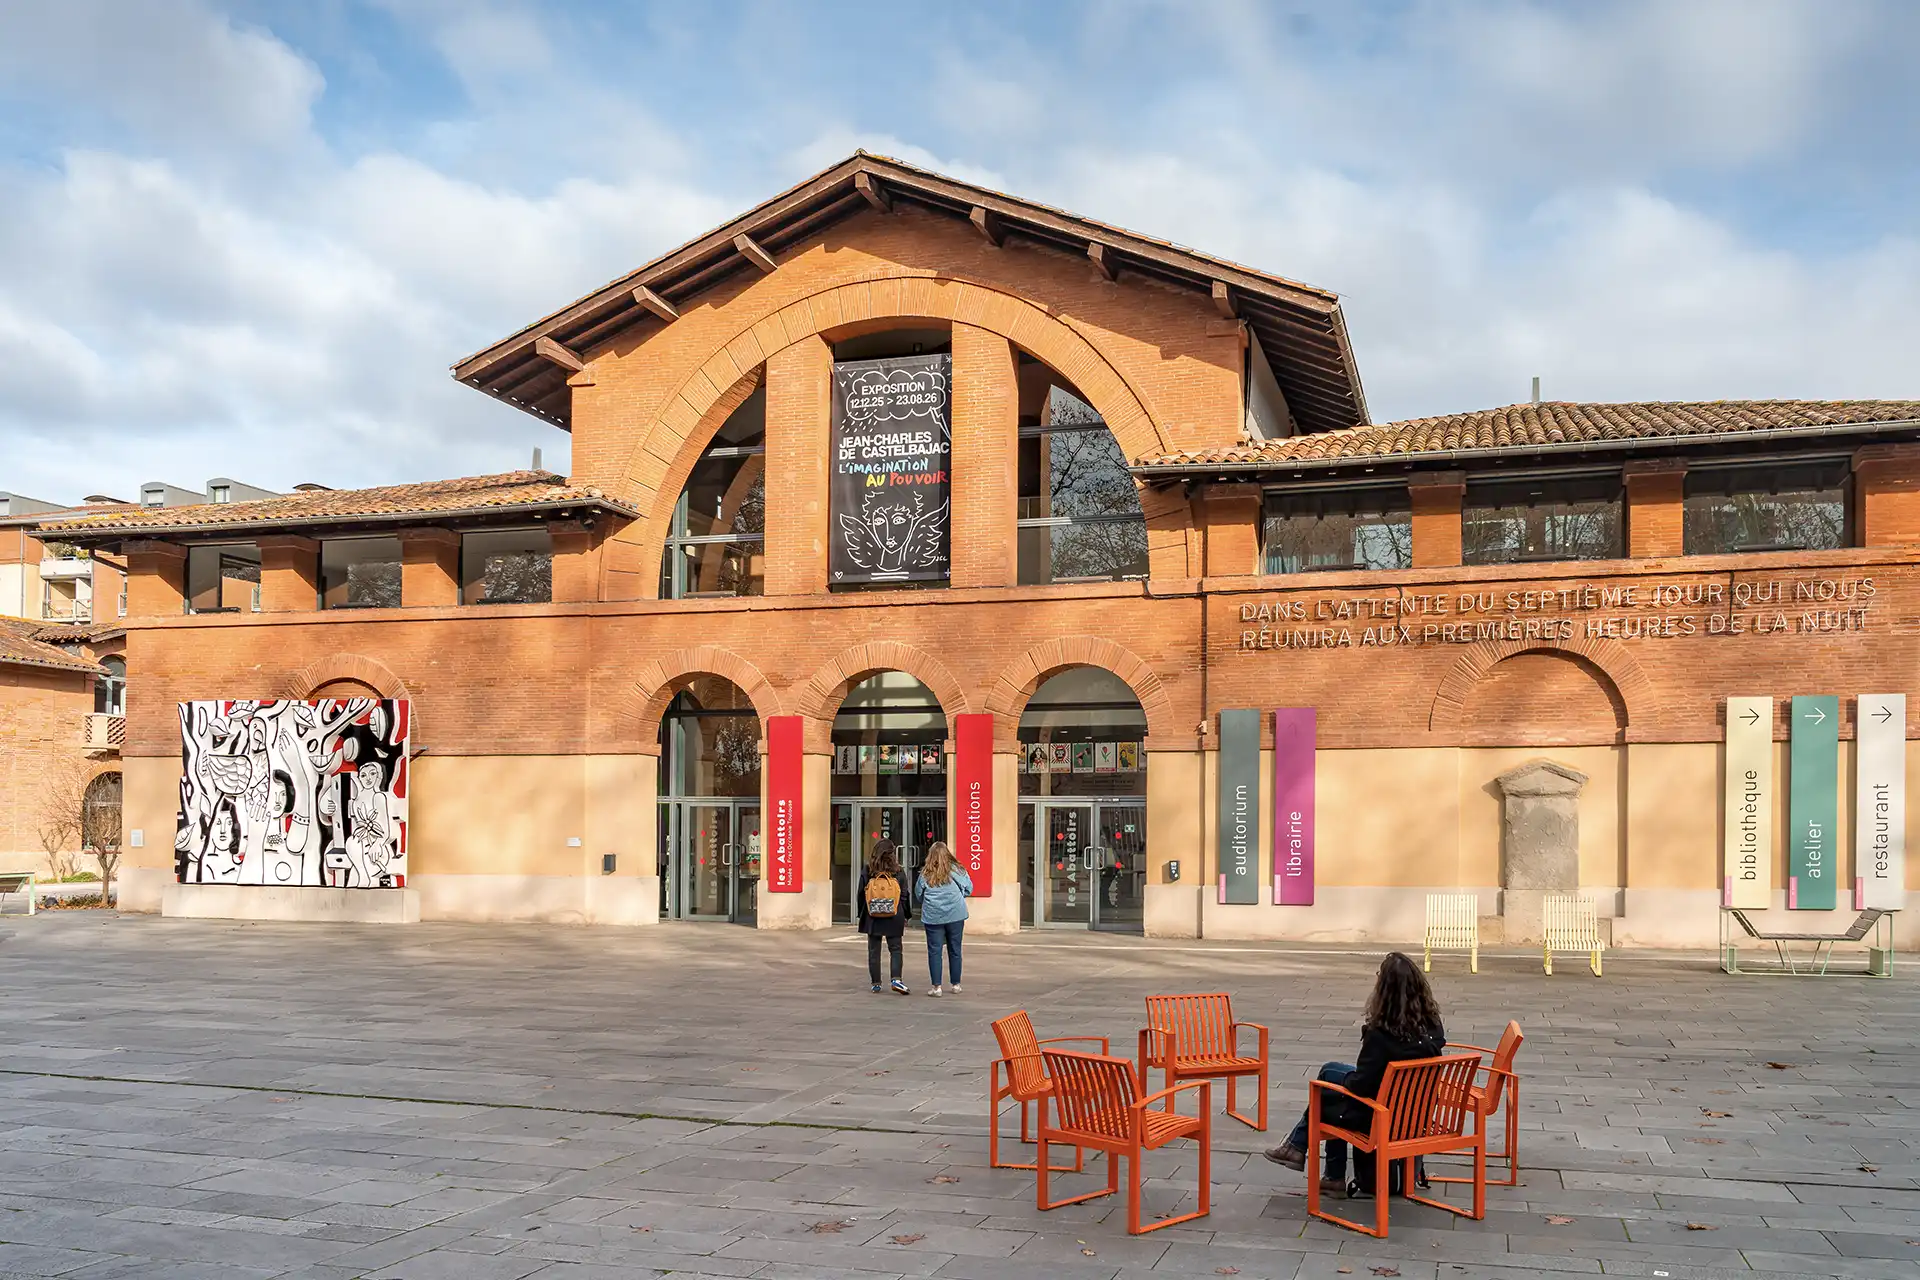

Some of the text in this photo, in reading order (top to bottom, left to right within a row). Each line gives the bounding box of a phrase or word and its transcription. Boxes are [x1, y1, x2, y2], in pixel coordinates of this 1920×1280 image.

[850, 397, 884, 408] 12.12.25
[896, 393, 937, 405] 23.08.26
[861, 381, 925, 395] EXPOSITION
[839, 431, 932, 448] JEAN-CHARLES
[839, 442, 950, 460] DE CASTELBAJAC
[866, 474, 886, 487] AU
[1241, 577, 1876, 620] DANS L'ATTENTE DU SEPTIÈME JOUR QUI NOUS
[1242, 608, 1871, 649] RÉUNIRA AUX PREMIÈRES HEURES DE LA NUIT
[708, 809, 718, 876] Abattoirs
[776, 800, 786, 886] les Abattoirs
[966, 781, 984, 871] expositions
[1231, 785, 1247, 876] auditorium
[1287, 811, 1302, 877] librairie
[1739, 770, 1762, 880] bibliothèque
[1804, 819, 1822, 878] atelier
[1872, 783, 1889, 879] restaurant
[1066, 811, 1077, 907] les Abattoirs
